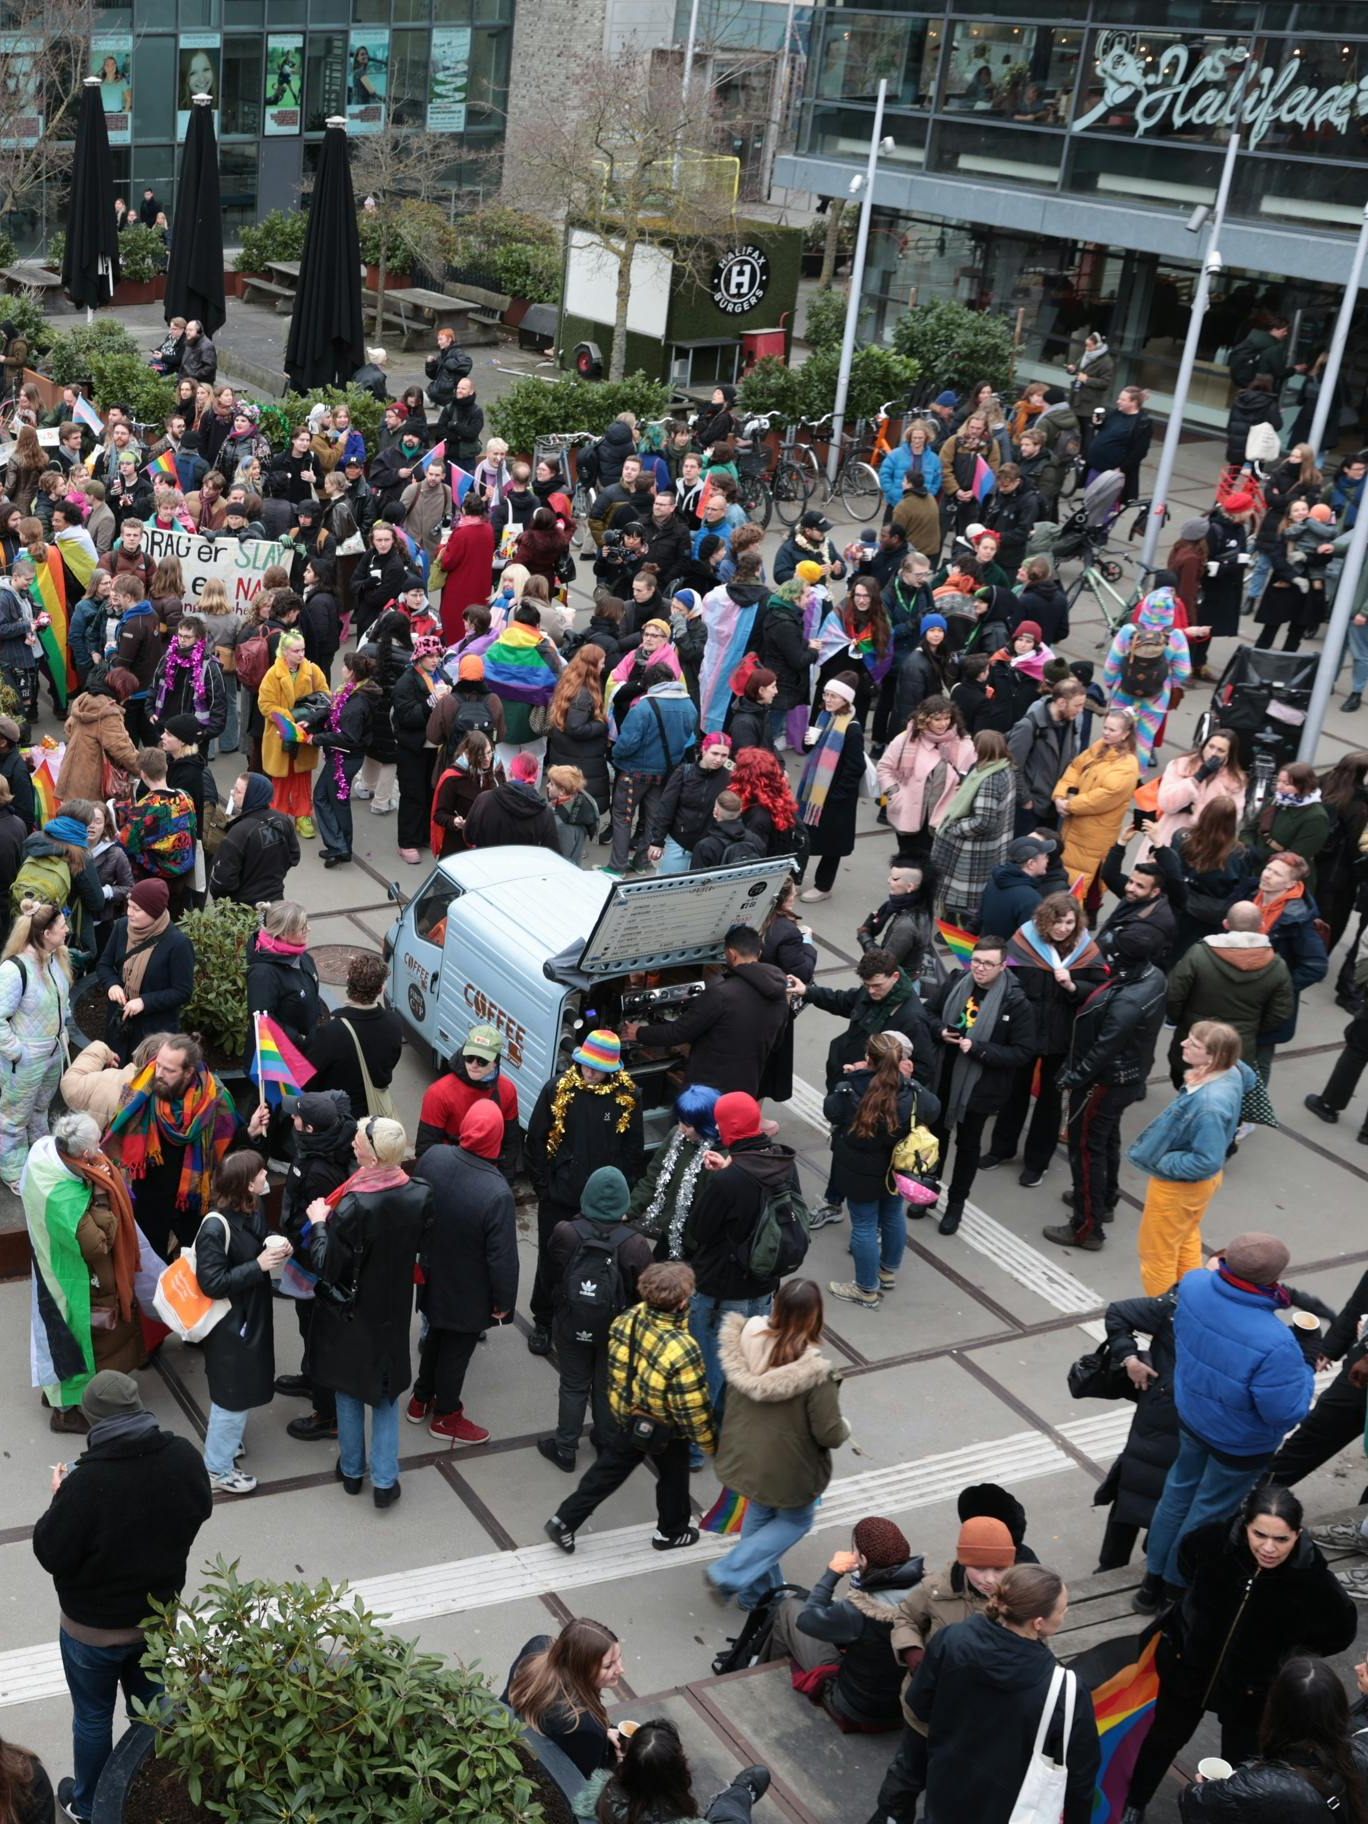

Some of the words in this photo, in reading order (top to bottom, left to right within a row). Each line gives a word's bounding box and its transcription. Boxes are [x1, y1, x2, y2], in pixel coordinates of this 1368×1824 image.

[718, 246, 766, 269] HALIFAX
[729, 264, 752, 295] H
[714, 289, 764, 313] BURGERS
[143, 530, 191, 558] DRAG
[197, 544, 228, 563] er
[234, 542, 287, 570] SLAY
[235, 577, 263, 601] NA
[404, 952, 429, 979] COFFEE
[463, 983, 526, 1042] COFFEE
